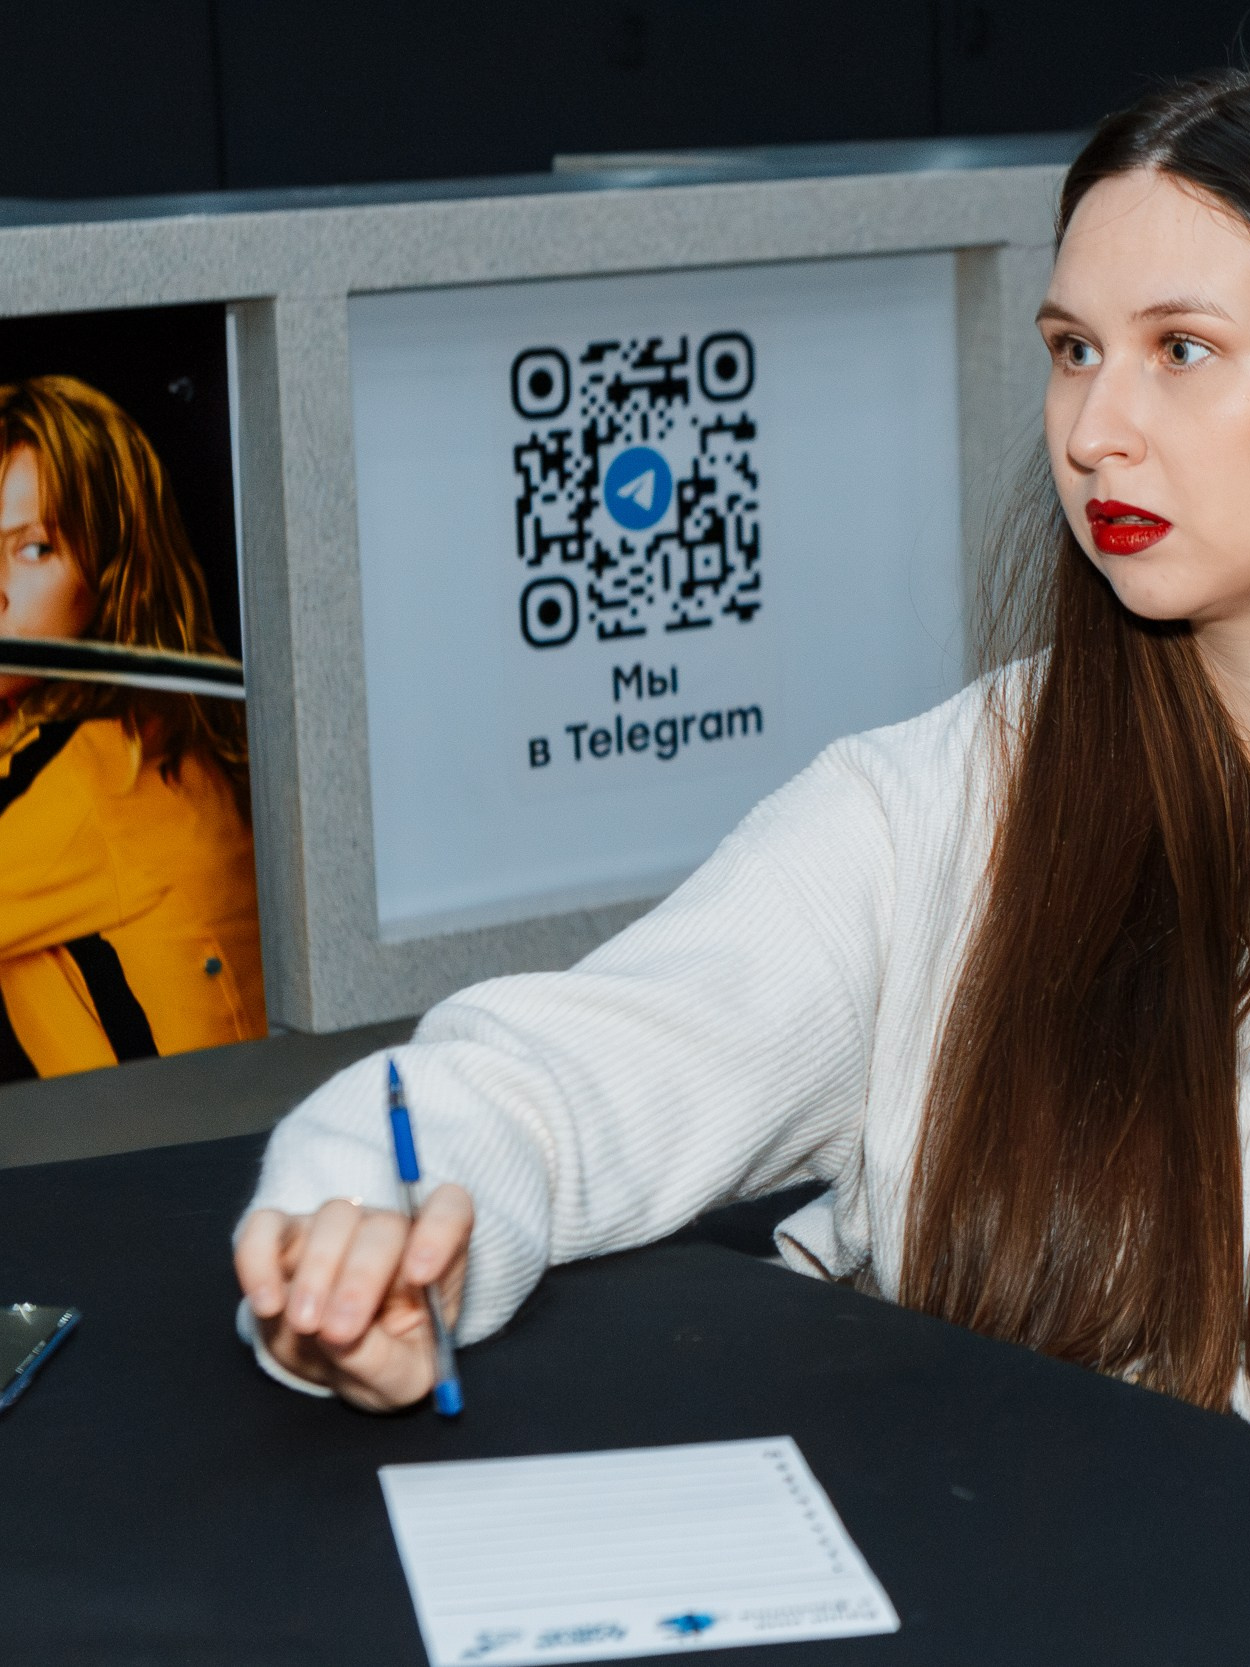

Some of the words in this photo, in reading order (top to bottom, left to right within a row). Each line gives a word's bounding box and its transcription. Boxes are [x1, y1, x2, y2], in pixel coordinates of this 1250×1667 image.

[612, 663, 679, 702] Мы
[528, 737, 551, 768] в
[564, 704, 763, 761] Telegram
